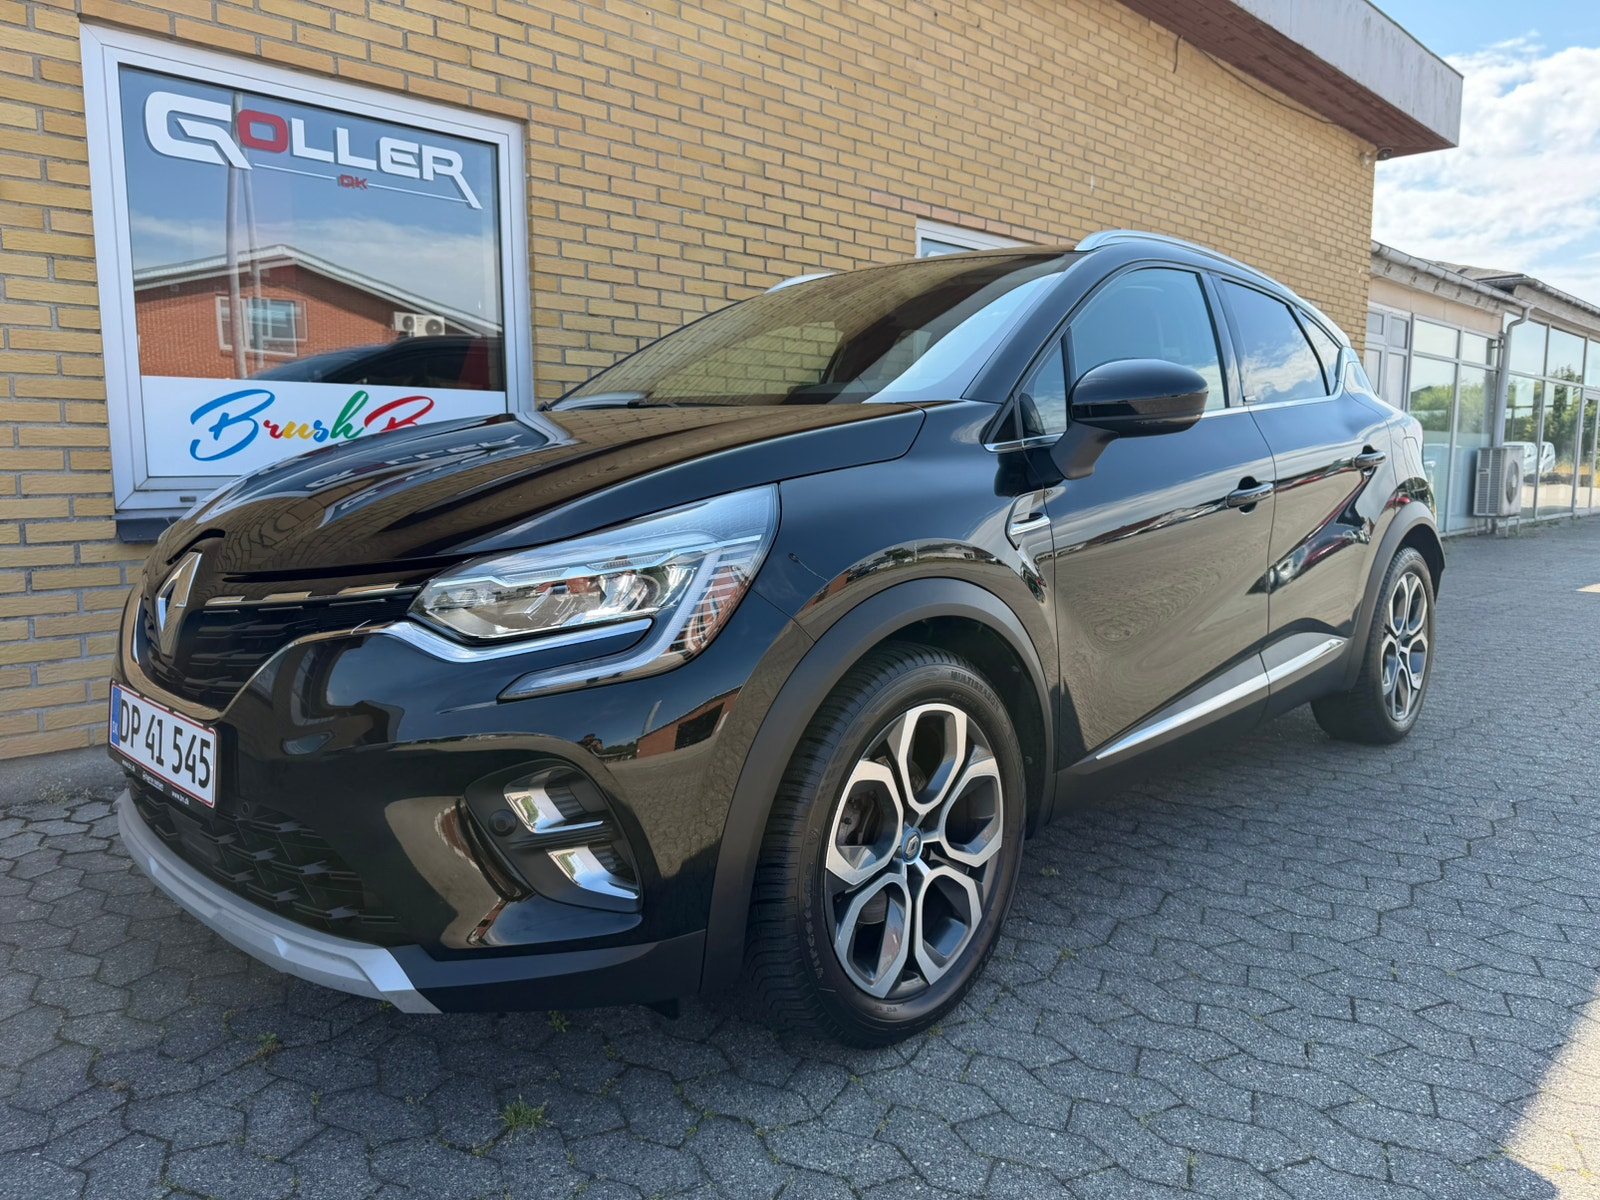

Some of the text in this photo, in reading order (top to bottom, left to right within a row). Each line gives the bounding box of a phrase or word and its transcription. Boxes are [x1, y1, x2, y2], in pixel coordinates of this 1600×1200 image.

[145, 91, 482, 209] GOLLER
[339, 174, 368, 190] DK
[120, 698, 211, 789] DP 41 545
